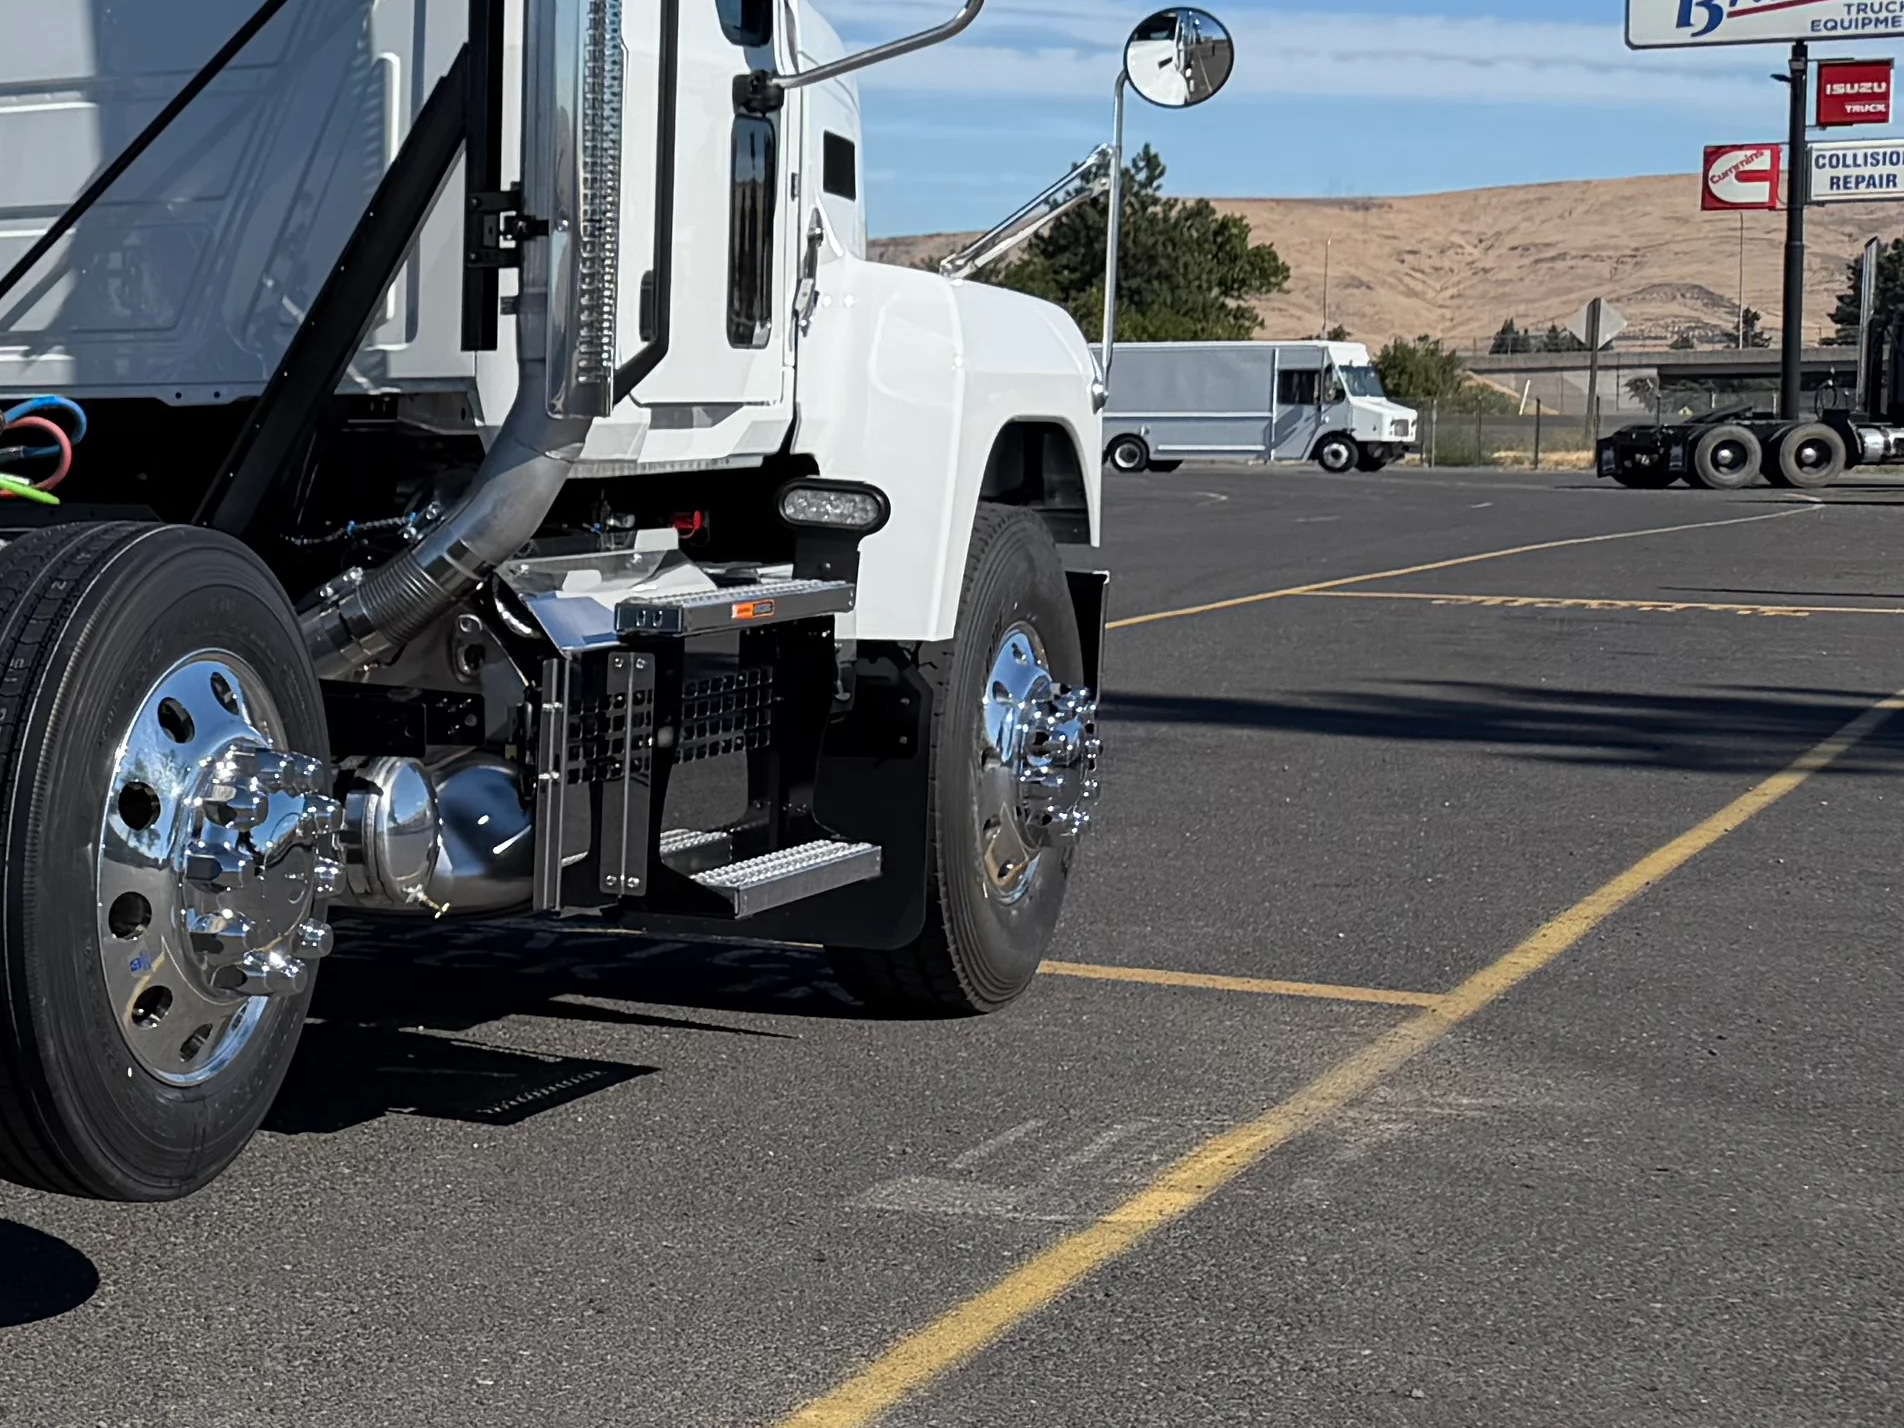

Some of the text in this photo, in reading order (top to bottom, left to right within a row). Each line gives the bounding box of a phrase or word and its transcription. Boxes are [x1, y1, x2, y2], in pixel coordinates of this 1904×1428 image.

[1826, 81, 1887, 96] ISUZU
[1844, 103, 1887, 114] TRUCK
[1814, 150, 1904, 170] COLLISIO
[1829, 173, 1898, 191] REPAIR
